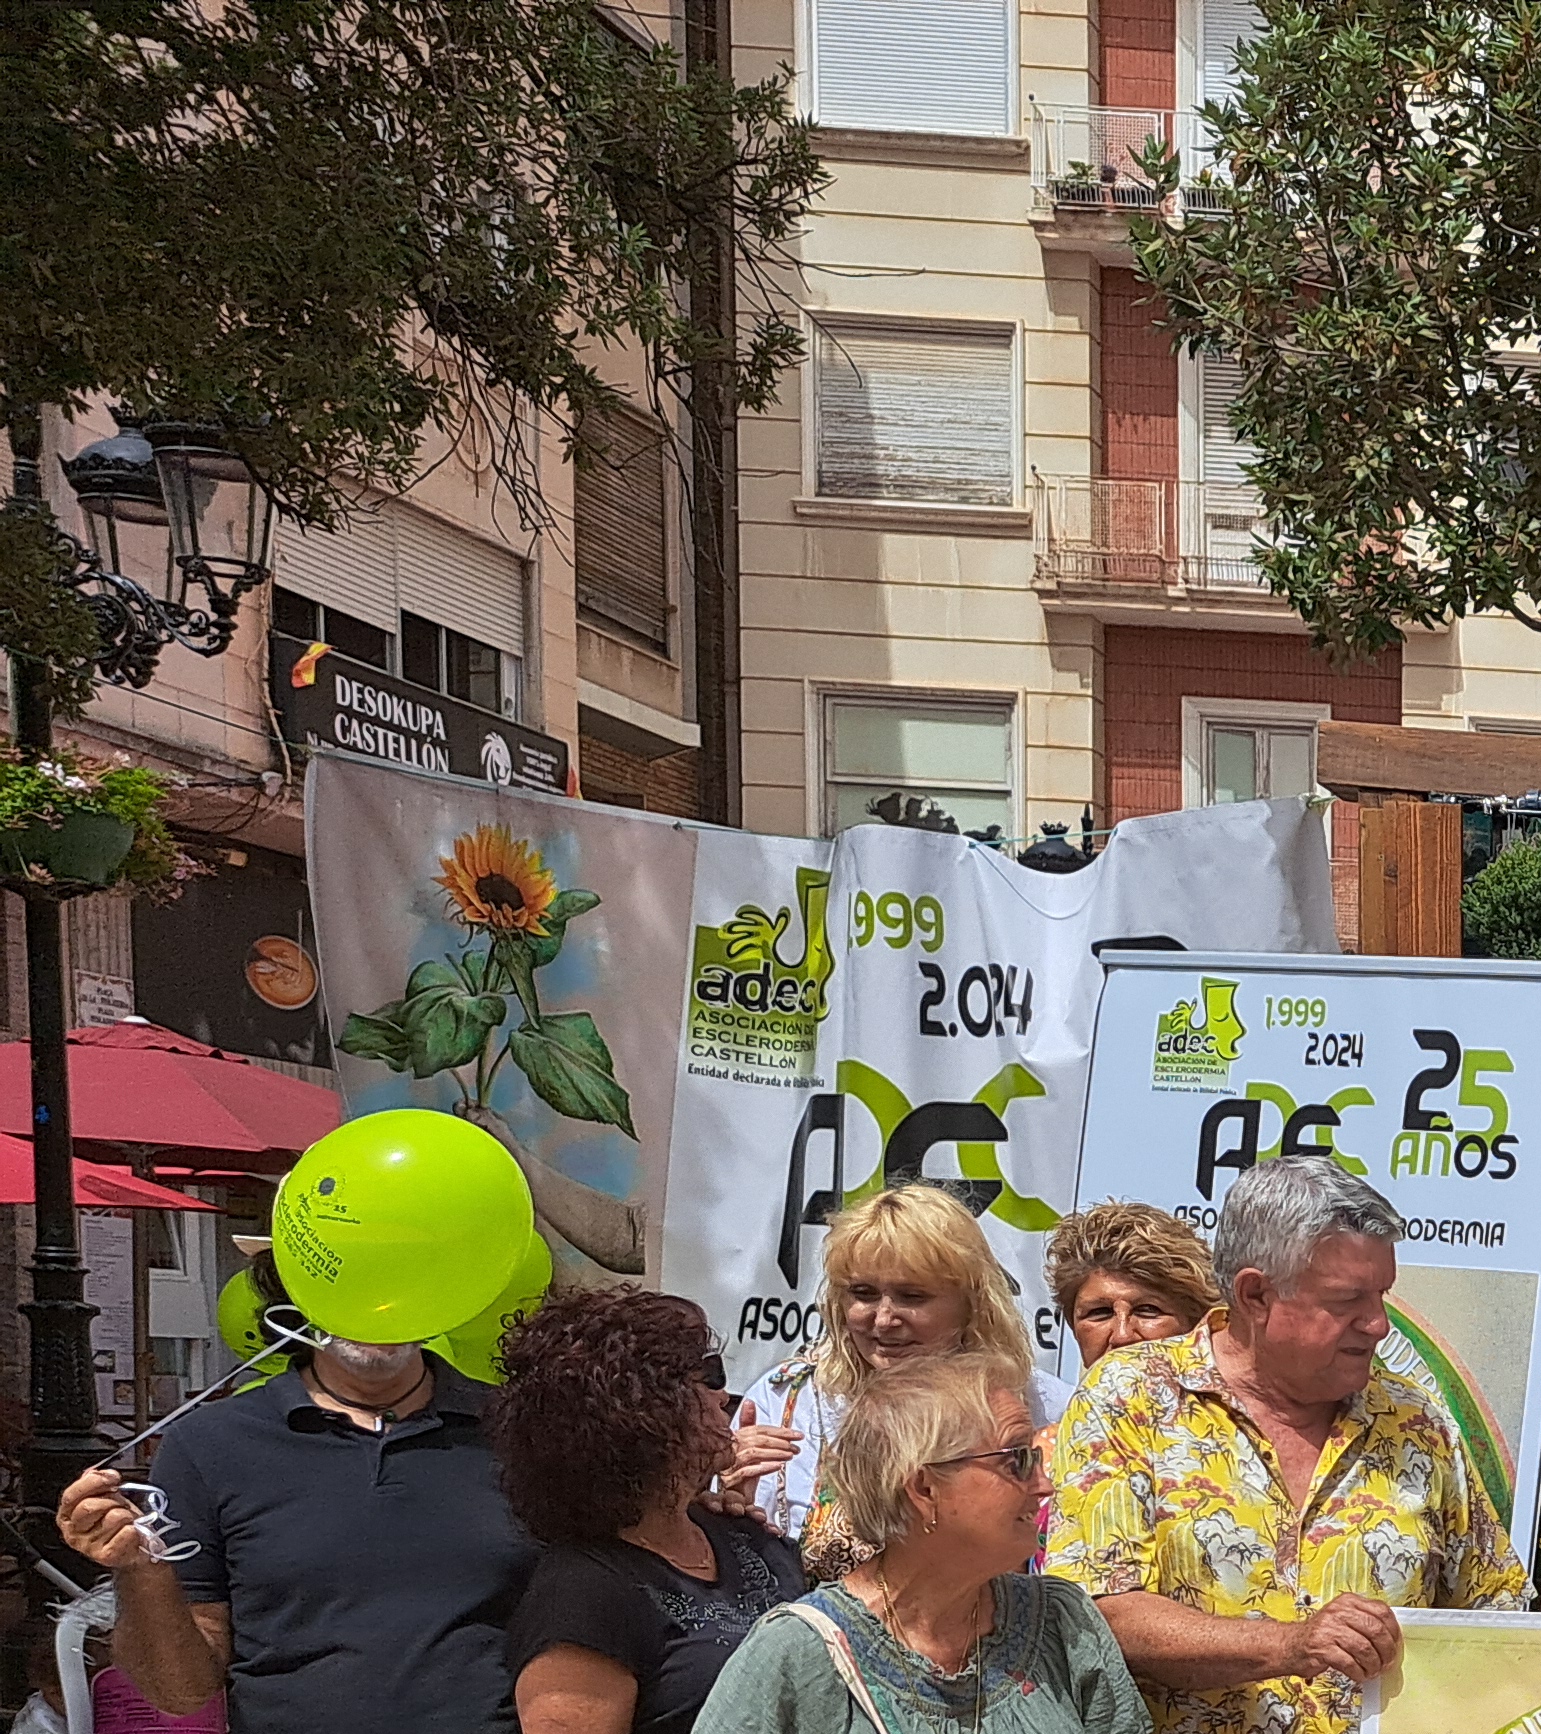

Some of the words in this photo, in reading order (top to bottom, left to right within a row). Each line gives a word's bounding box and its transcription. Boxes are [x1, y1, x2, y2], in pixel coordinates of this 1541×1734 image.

[334, 674, 448, 740] DESOKUPA
[333, 712, 450, 773] CASTELLÓN
[694, 1009, 803, 1036] ASOCIACIÓN
[1265, 996, 1327, 1030] 1.999
[690, 1044, 797, 1069] CASTELLÓN
[1157, 1029, 1217, 1054] adec
[1304, 1032, 1364, 1067] 2.024
[687, 1062, 729, 1080] Entidad
[732, 1070, 781, 1087] declarada
[1402, 1028, 1515, 1153] 25
[1389, 1115, 1520, 1180] AÑOS
